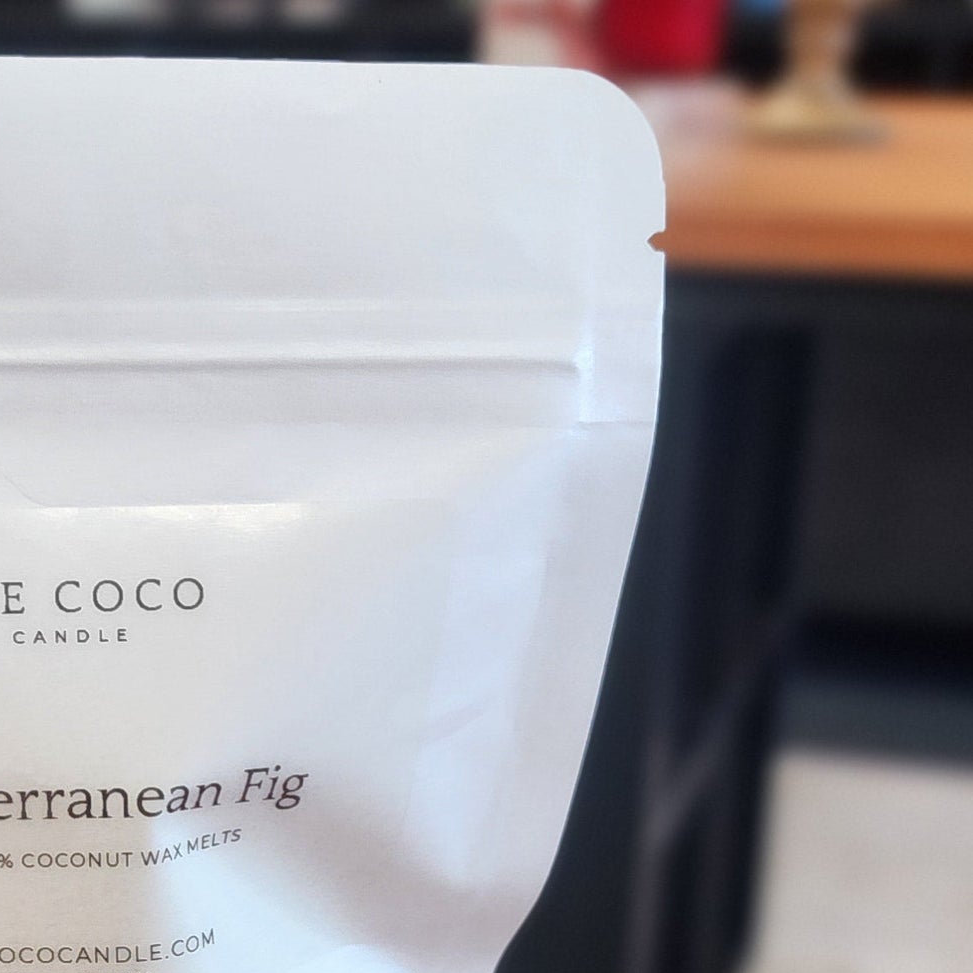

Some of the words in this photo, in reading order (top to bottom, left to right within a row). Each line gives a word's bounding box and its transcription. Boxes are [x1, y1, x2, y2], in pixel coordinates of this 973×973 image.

[55, 577, 205, 613] COCO
[13, 629, 129, 645] CANDLE
[234, 764, 311, 810] Fig
[21, 852, 134, 869] COCONUT
[140, 842, 185, 867] WAX
[186, 828, 242, 855] MELTS
